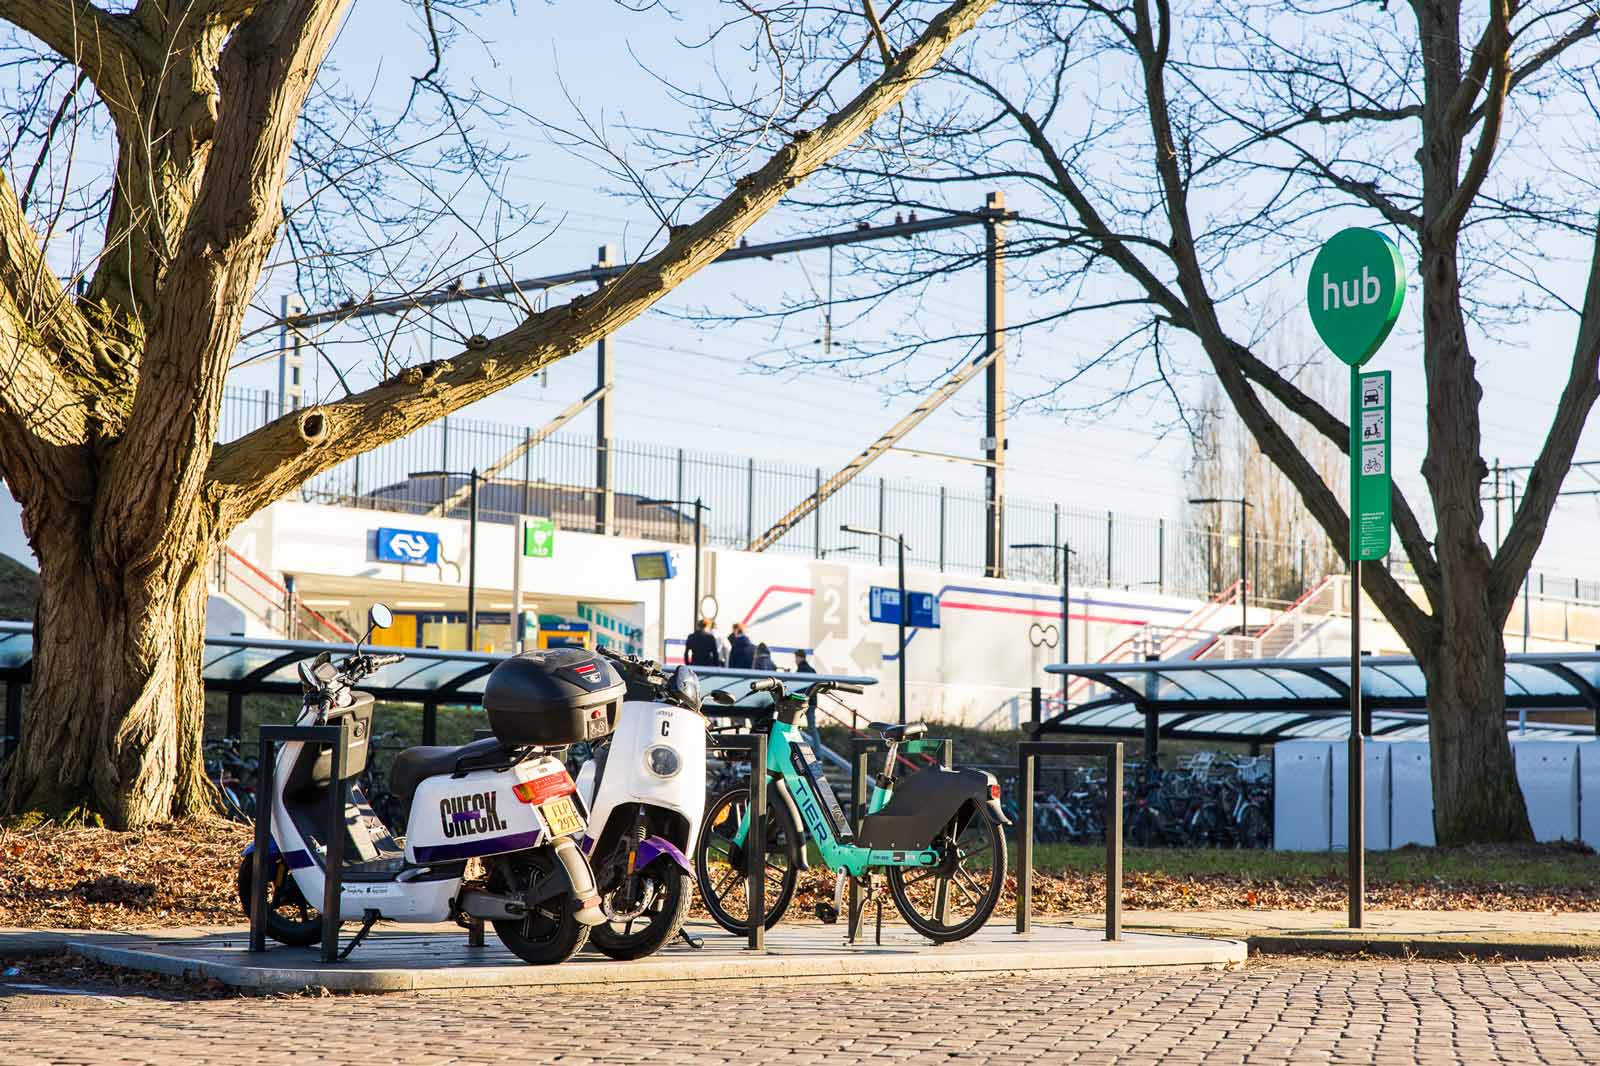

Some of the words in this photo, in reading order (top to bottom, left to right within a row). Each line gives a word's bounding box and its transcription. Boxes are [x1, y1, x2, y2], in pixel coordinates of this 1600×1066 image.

[1323, 265, 1381, 311] hub
[823, 588, 841, 624] 2
[661, 720, 670, 737] C
[440, 791, 508, 839] CHECK.
[796, 778, 828, 845] TIER
